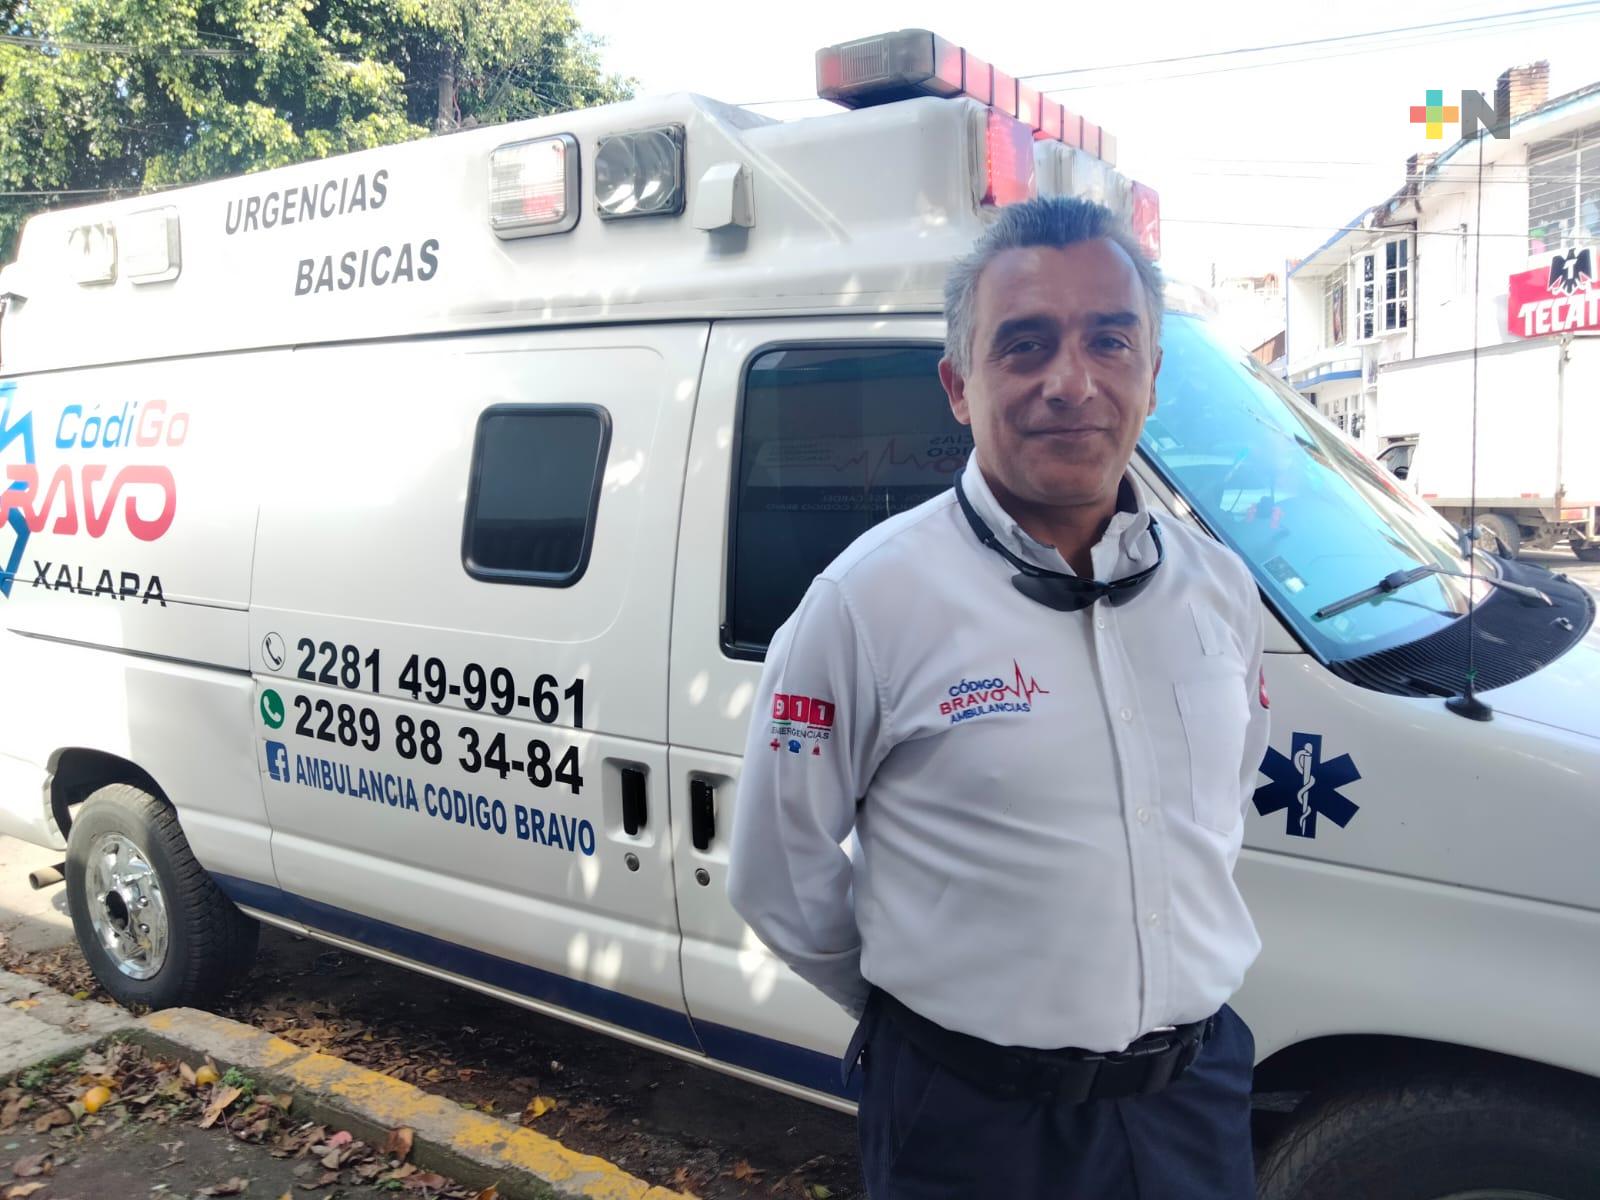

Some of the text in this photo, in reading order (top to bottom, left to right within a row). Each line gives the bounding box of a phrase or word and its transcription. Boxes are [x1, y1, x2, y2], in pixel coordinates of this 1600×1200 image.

[225, 169, 389, 235] URGENCIAS
[295, 238, 439, 296] BASICAS
[1518, 289, 1600, 336] TECAT
[0, 464, 177, 542] RAVO
[33, 560, 167, 607] XALAPA
[297, 637, 585, 728] 2281 49-99-61
[940, 689, 1004, 715] BRAVO
[949, 679, 1004, 697] CÓDIGO
[771, 727, 830, 740] EMERGENCIAS
[776, 699, 827, 721] 911
[951, 702, 1031, 724] AMBULANCIAS
[294, 695, 584, 795] 2289 88 34-84
[296, 754, 419, 812] AMBULANCIA
[423, 783, 507, 835] CODIGO
[514, 804, 596, 857] BRAVO
